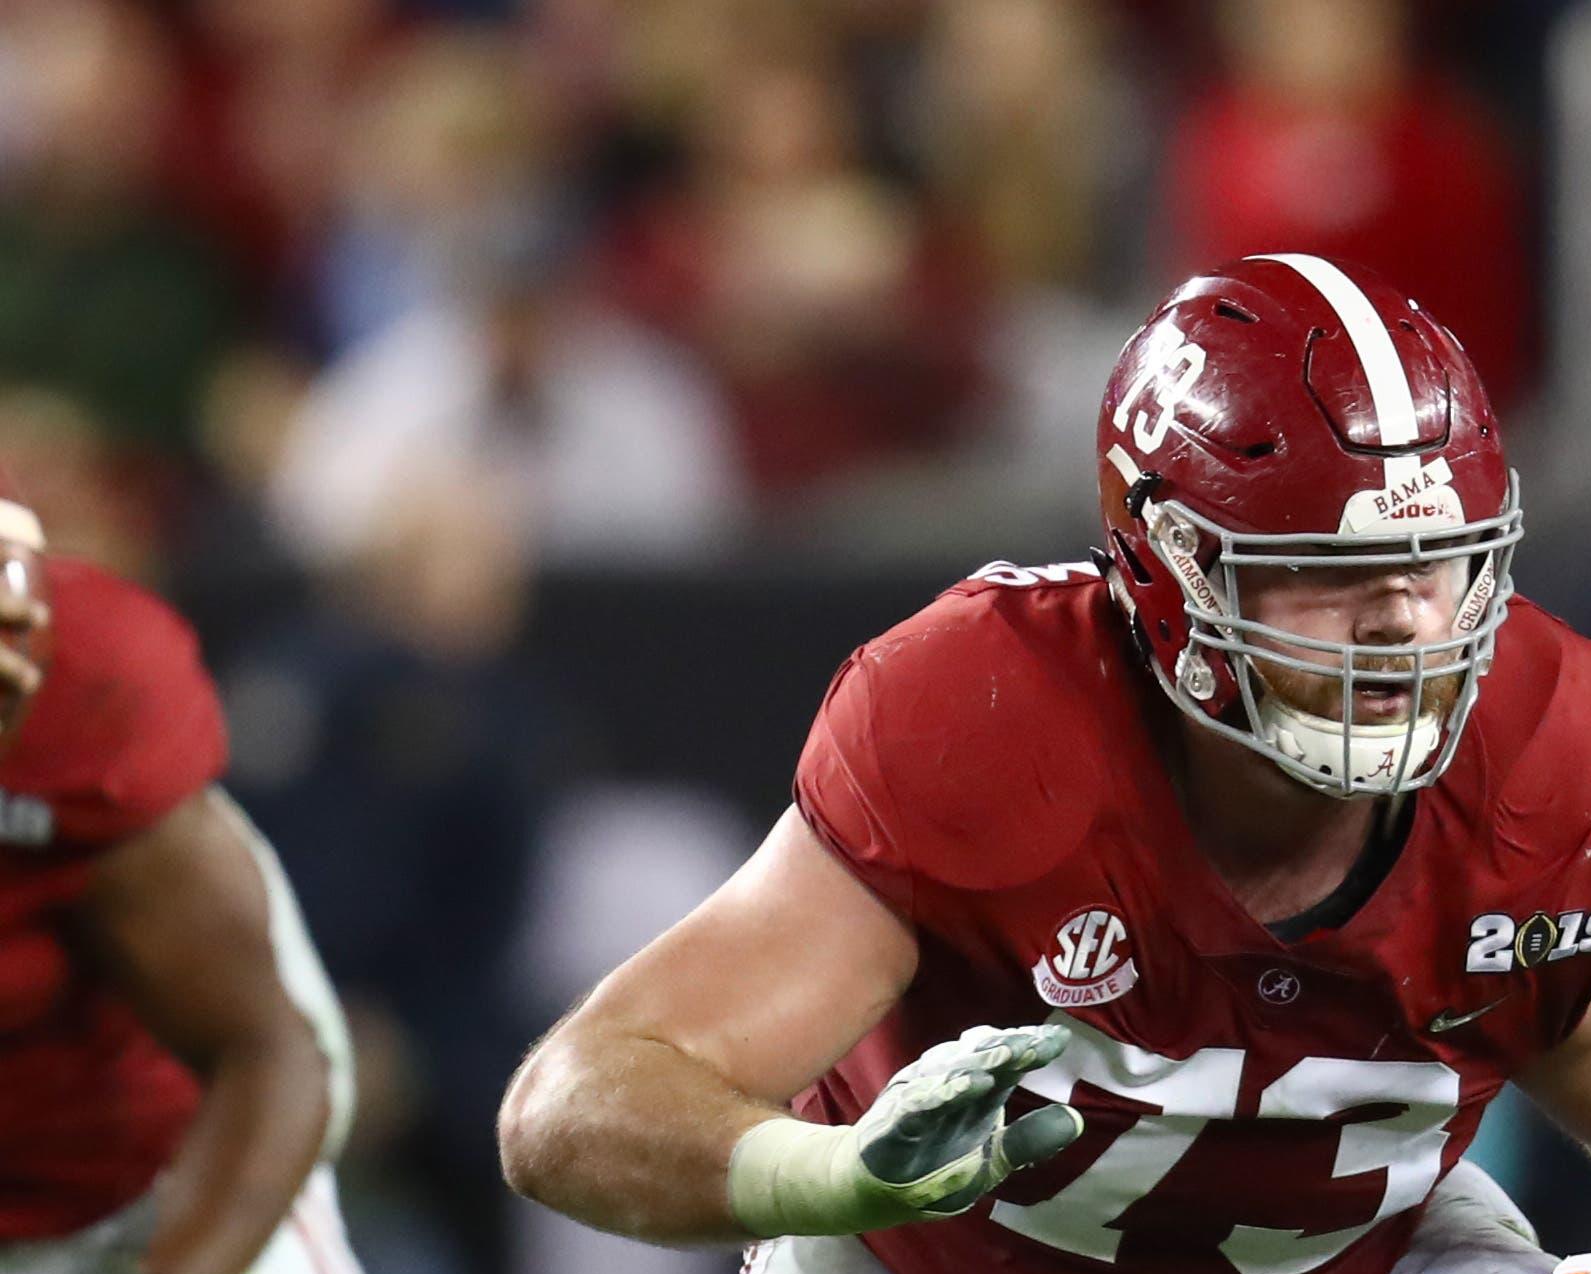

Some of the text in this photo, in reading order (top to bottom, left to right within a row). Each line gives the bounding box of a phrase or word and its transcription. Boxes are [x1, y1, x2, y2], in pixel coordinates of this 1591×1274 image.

[1112, 314, 1207, 455] 73
[1374, 471, 1435, 514] BAMA
[1053, 911, 1127, 979] SEC
[1041, 977, 1121, 1004] GRADUATE
